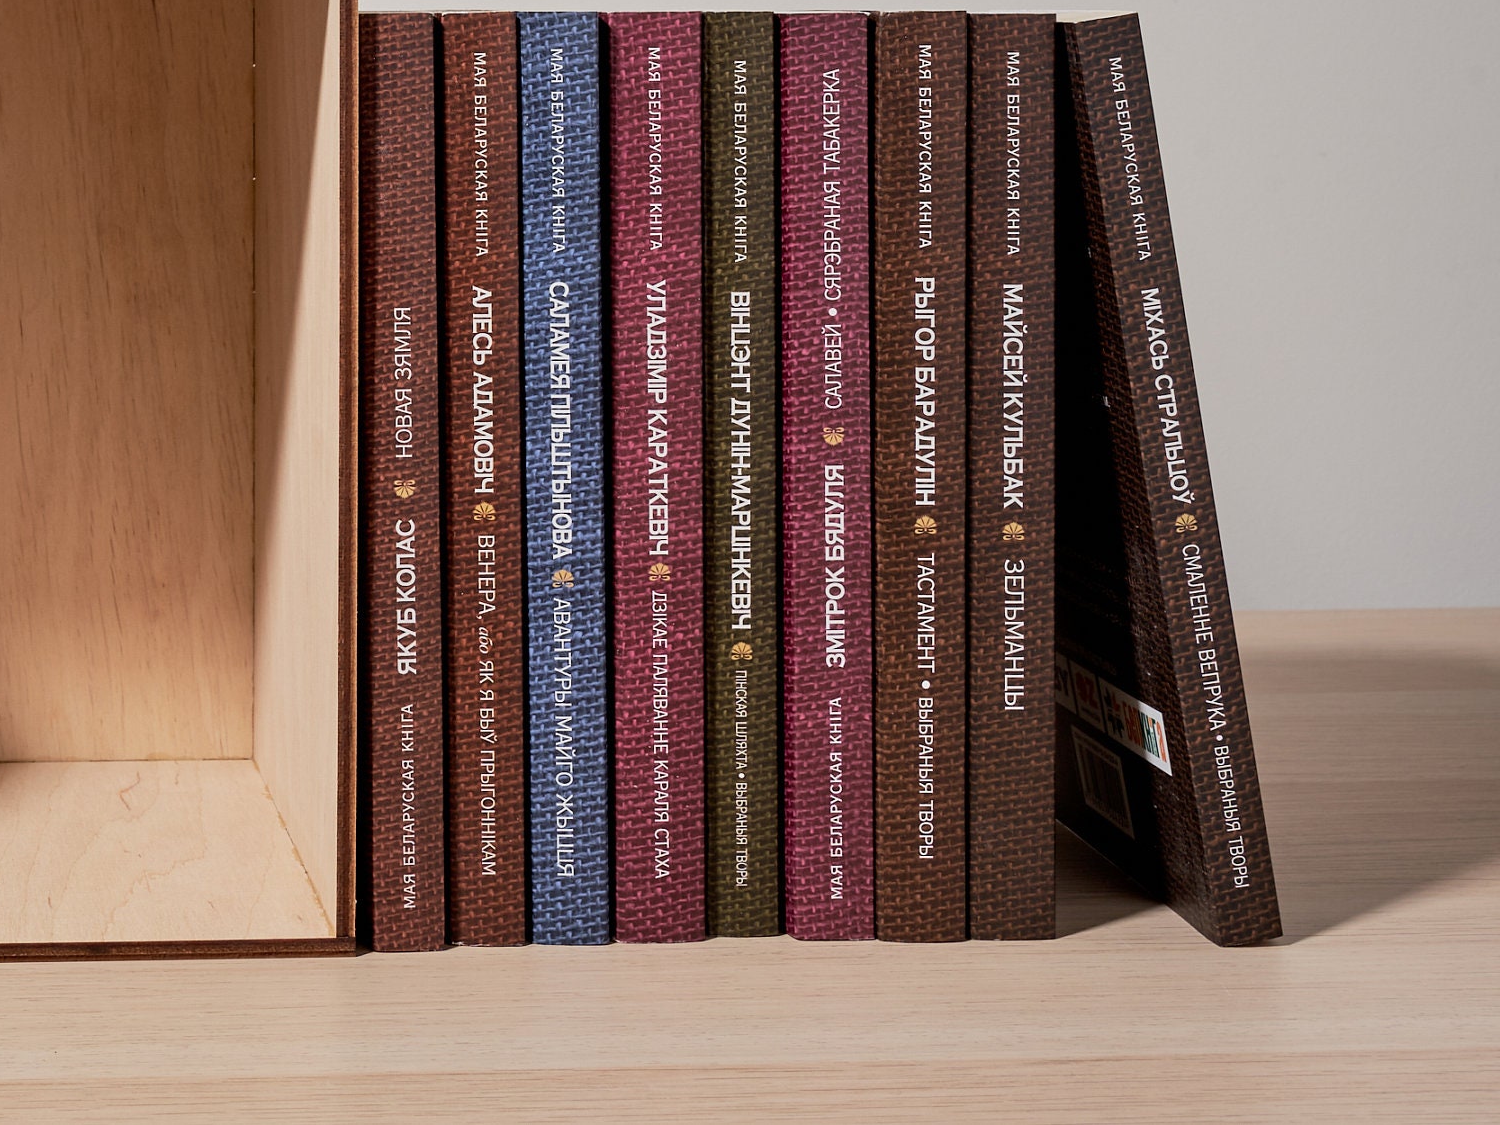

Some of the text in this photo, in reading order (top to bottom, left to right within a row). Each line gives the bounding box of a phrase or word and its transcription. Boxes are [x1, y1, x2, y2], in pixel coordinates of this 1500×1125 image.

[393, 306, 417, 909] МАЯ БЕЛАРУСКАЯ КНІГА ЯКУБ КОЛАС НОВАЯ ЗЯМЛЯ
[471, 52, 498, 875] МАЯ БЕЛАРУСКАЯ КНІГА АЛЕСЬ АДАМОВІЧ ВЕНЕРА, або ЯК Я БЫЎ ПРЫГОННІКАМ
[548, 48, 576, 877] МАЯ БЕЛАРУСКАЯ КНІГА САЛАМЕЯ ПІЛЬШТЫНОВА АВАНТУРЫ МАЙГО ЖЫЦЦЯ
[645, 47, 670, 879] МАЯ БЕЛАРУСКАЯ КНІГА УЛАДЗІМІР КАРАТКЕВІЧ ДЗІКАЕ ПАЛЯВАННЕ КАРАЛЯ СТАХА
[730, 60, 751, 887] МАЯ БЕЛАРУСКАЯ КНІГА ВІНЦЭНТ ДУНІН-МАРЦІНКЕВІЧ ПІНСКАЯ ШЛЯХТА ВЫБРАНЫЯ ТВОРЫ
[820, 68, 846, 899] МАЯ БЕЛАРУСКАЯ КНІГА ЗМІТРОК БЯДУЛЯ САЛАВЕЙ СЯРЭБРАНАЯ ТАБАКЕРКА
[914, 44, 936, 859] МАЯ БЕЛАРУСКАЯ КНІГА РЫГОР БАРАДУЛІН ТАСТАМЕНТ ВЫБРАНЫЯ ТВОРЫ
[1002, 51, 1028, 710] МАЯ БЕЛАРУСКАЯ КНІГА МАЙСЕЙ КУЛЬБАК ЗЕЛЬМАНЦЫ
[1108, 56, 1250, 888] МАЯ БЕЛАРУСКАЯ КНІГА МІХАСЬ СТРАЛЬЦОЎ СМАЛЕННЕ ВЕПРУКА ВЫБРАНЫЯ ТВОРЫ
